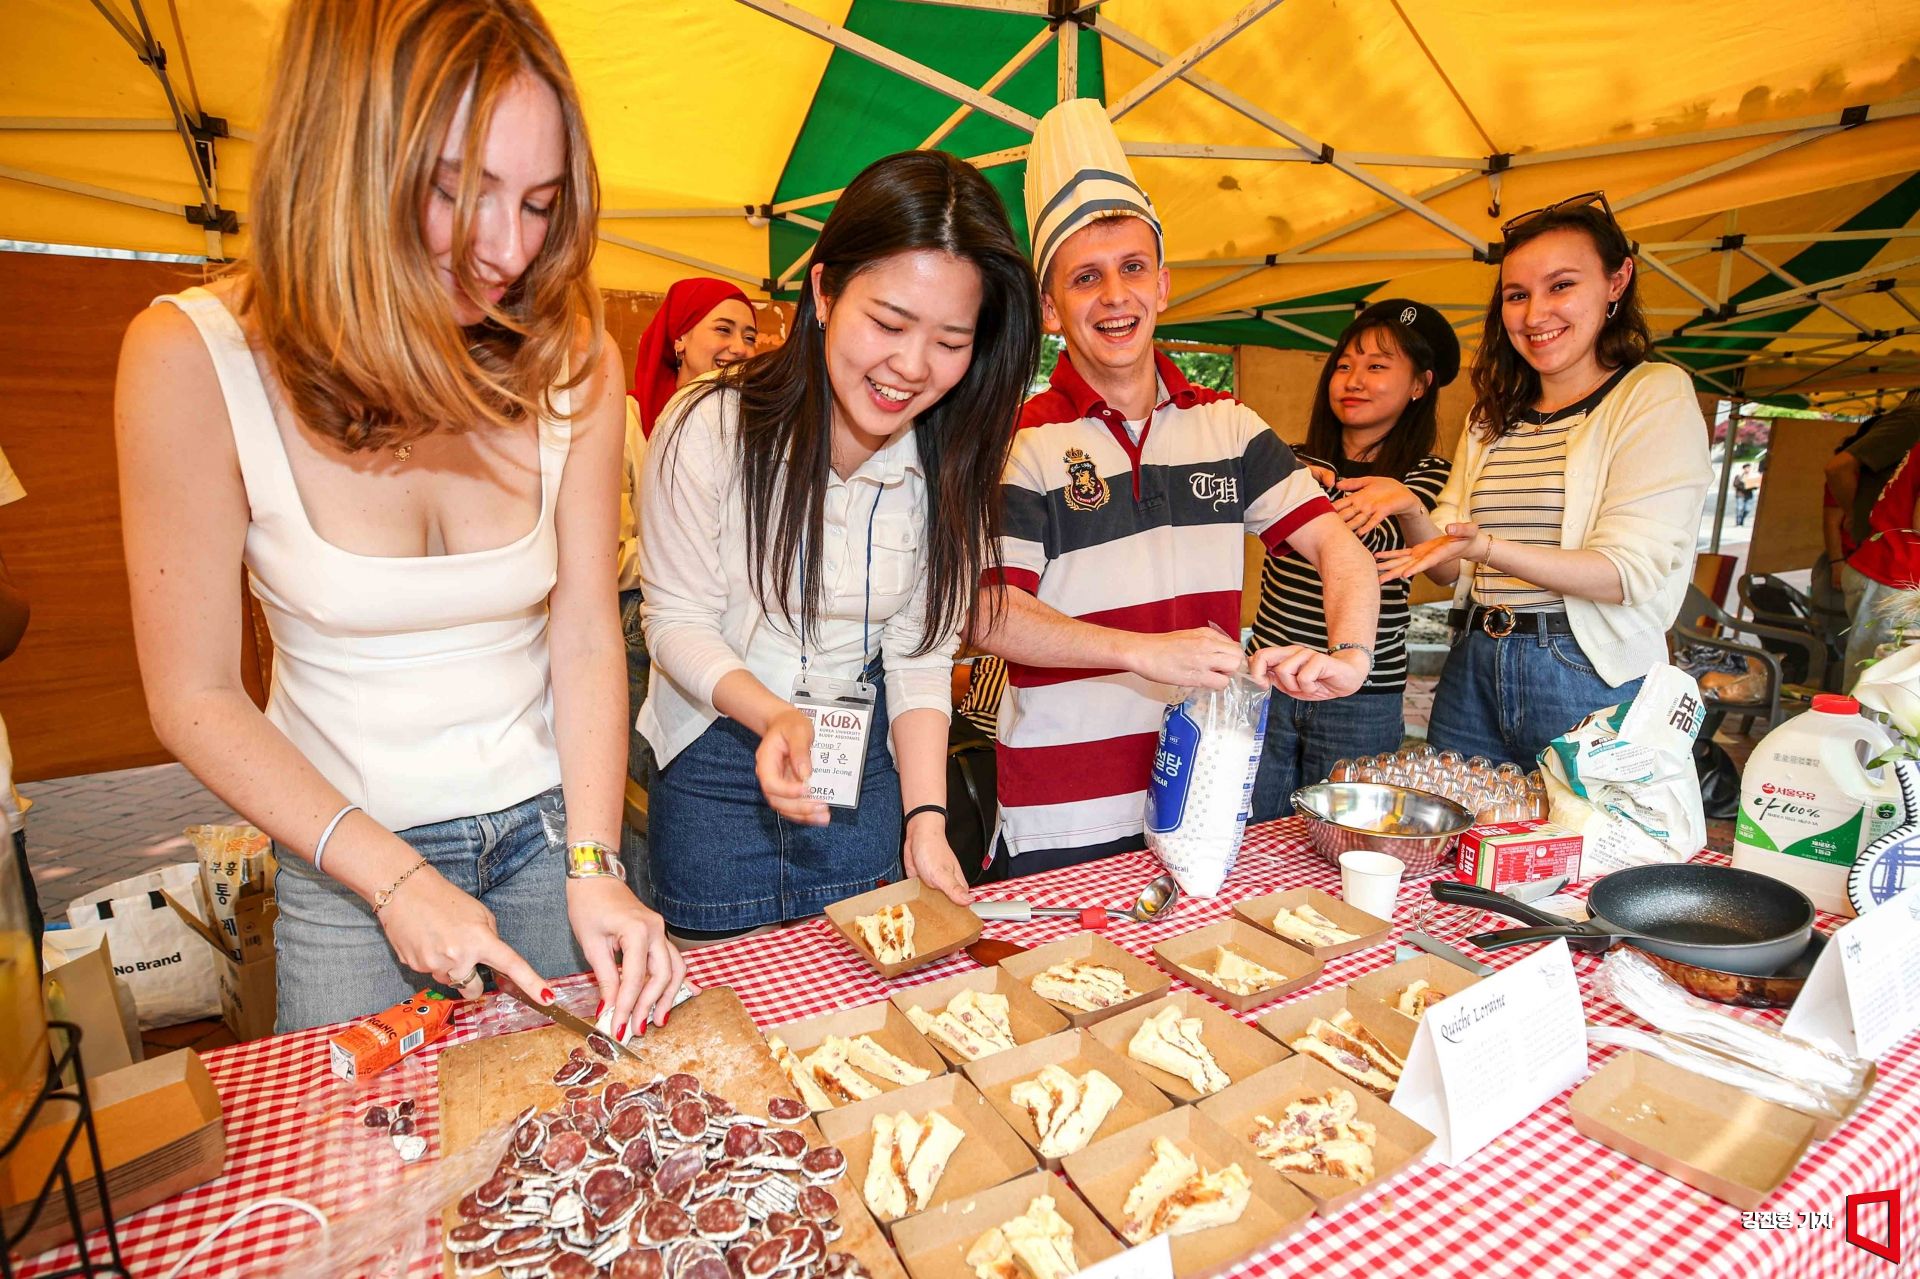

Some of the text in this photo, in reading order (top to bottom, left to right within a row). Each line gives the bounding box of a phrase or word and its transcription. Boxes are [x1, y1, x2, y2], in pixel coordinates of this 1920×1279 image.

[820, 713, 862, 730] KUBA
[1669, 692, 1698, 733] 곰표
[832, 767, 853, 777] Jeong
[1154, 750, 1183, 777] 설탕
[809, 786, 835, 795] OREA
[1776, 786, 1817, 801] 서울우유
[1463, 845, 1476, 877] 버터
[113, 952, 182, 976] No Brand
[366, 1017, 397, 1040] RGANIC
[1440, 1006, 1472, 1043] Quiche
